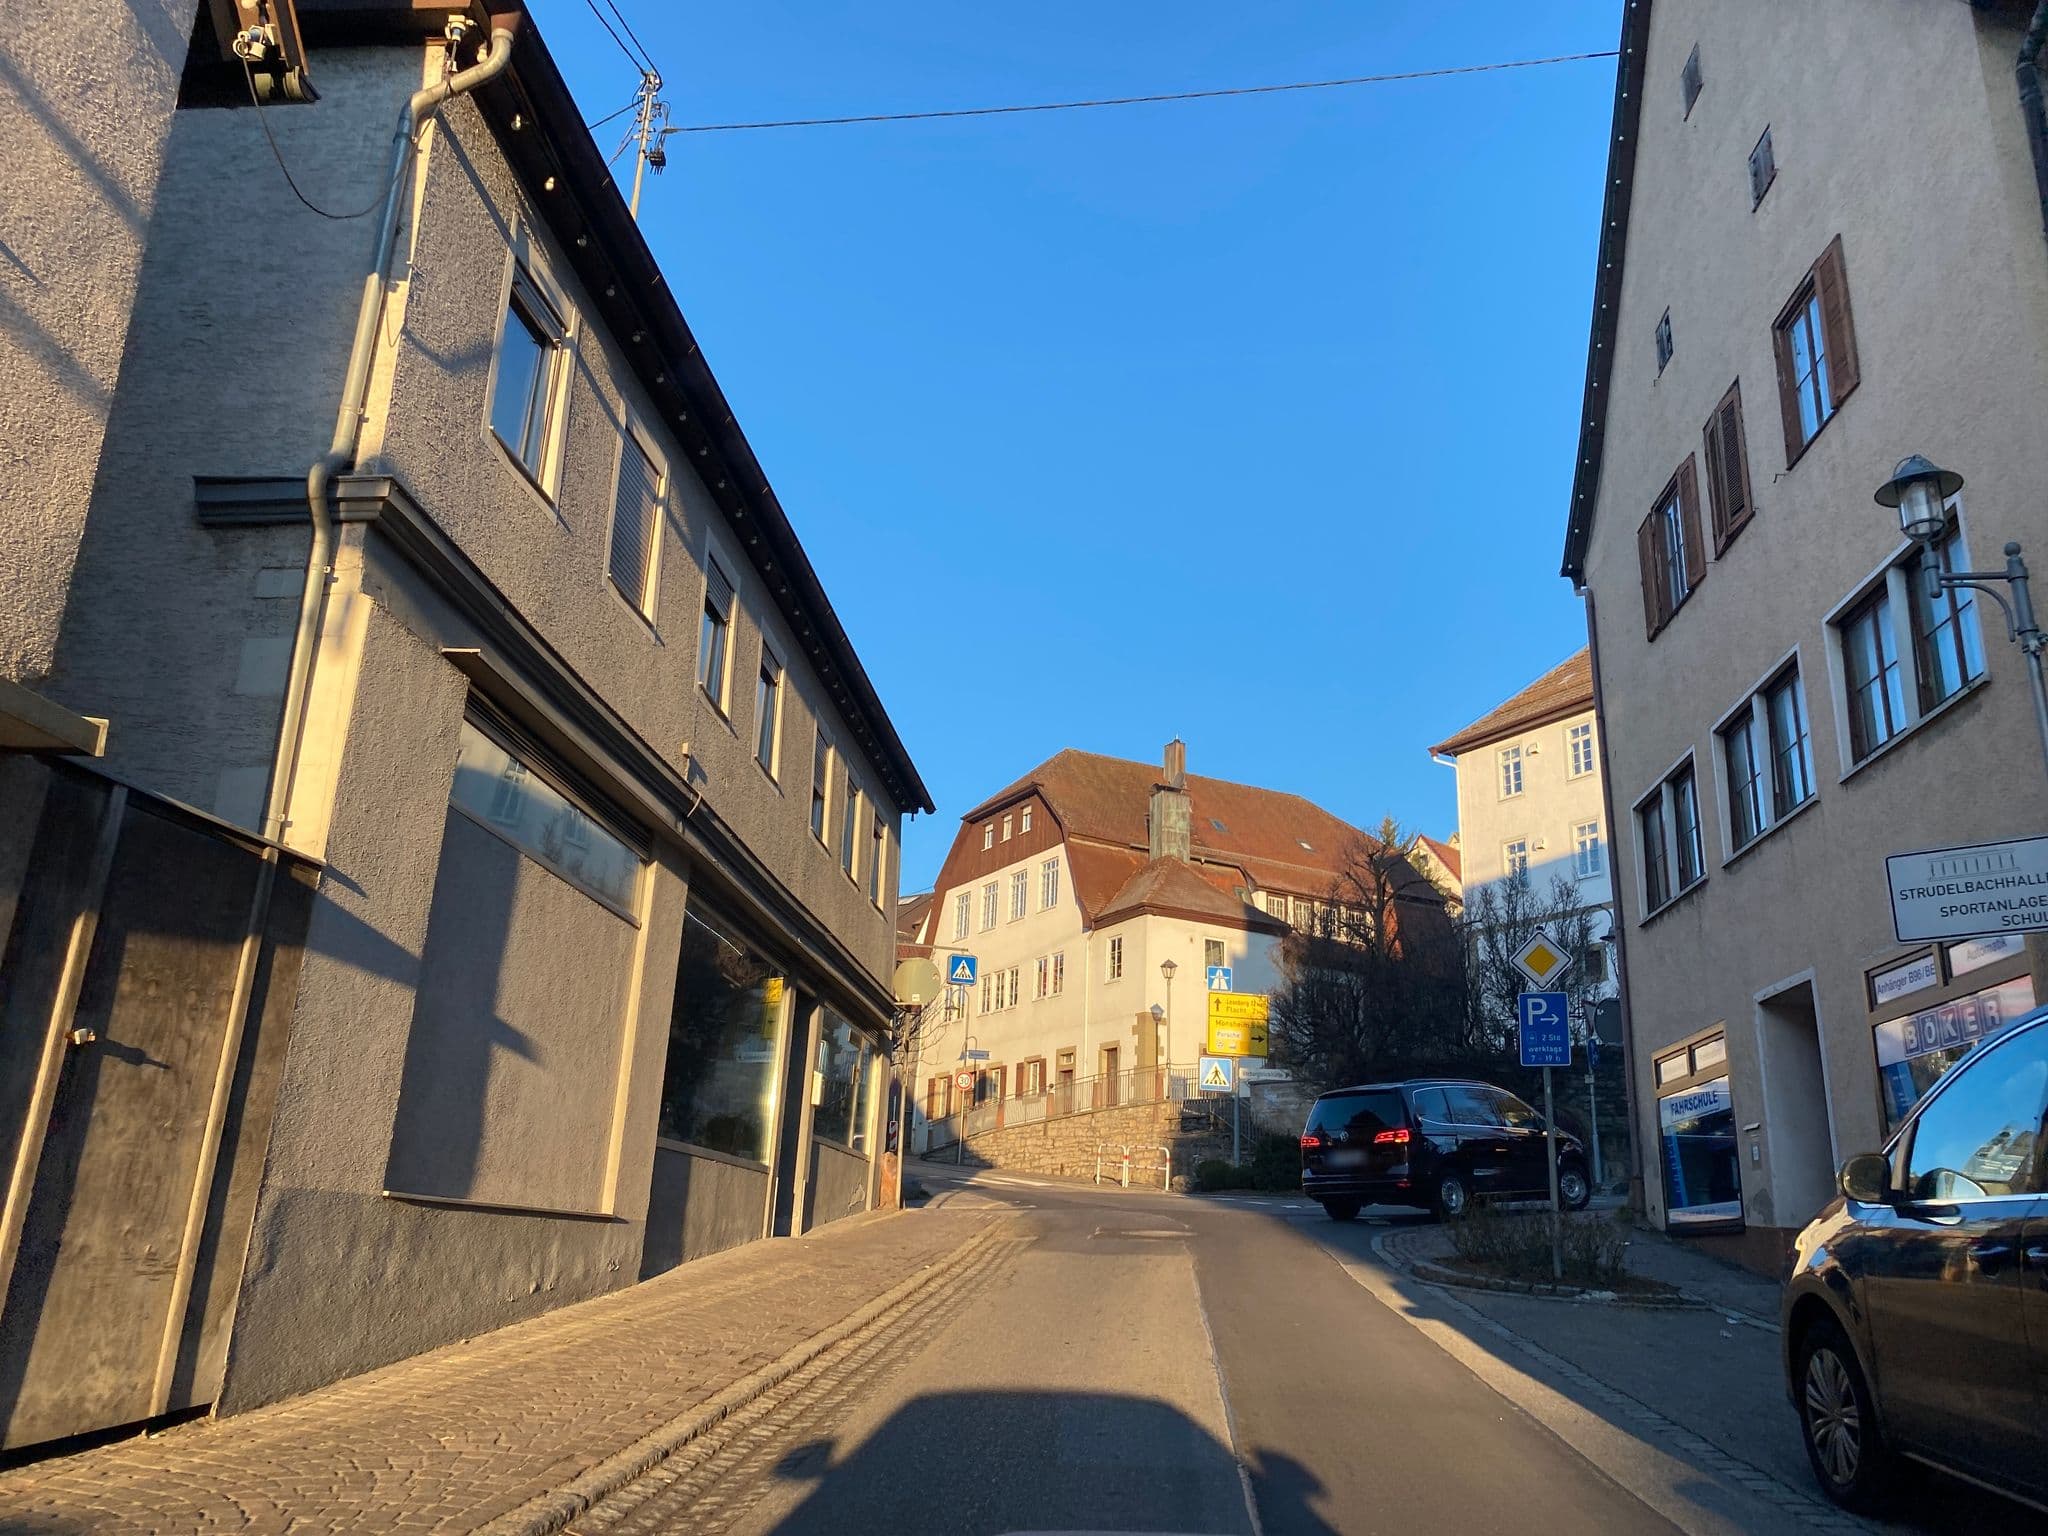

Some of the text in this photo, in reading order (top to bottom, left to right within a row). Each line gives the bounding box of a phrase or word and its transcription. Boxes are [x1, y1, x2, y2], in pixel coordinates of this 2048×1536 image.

[1900, 872, 2048, 901] STRUDELBACHHALL
[1940, 895, 2048, 918] SPORTANLAGE
[1877, 975, 1907, 995] Anhänger
[1527, 998, 1547, 1026] P
[1904, 998, 2001, 1050] BÖKER
[1528, 1045, 1563, 1054] werktags
[959, 1076, 969, 1085] 30
[1671, 1090, 1718, 1116] FAHRSCHULE
